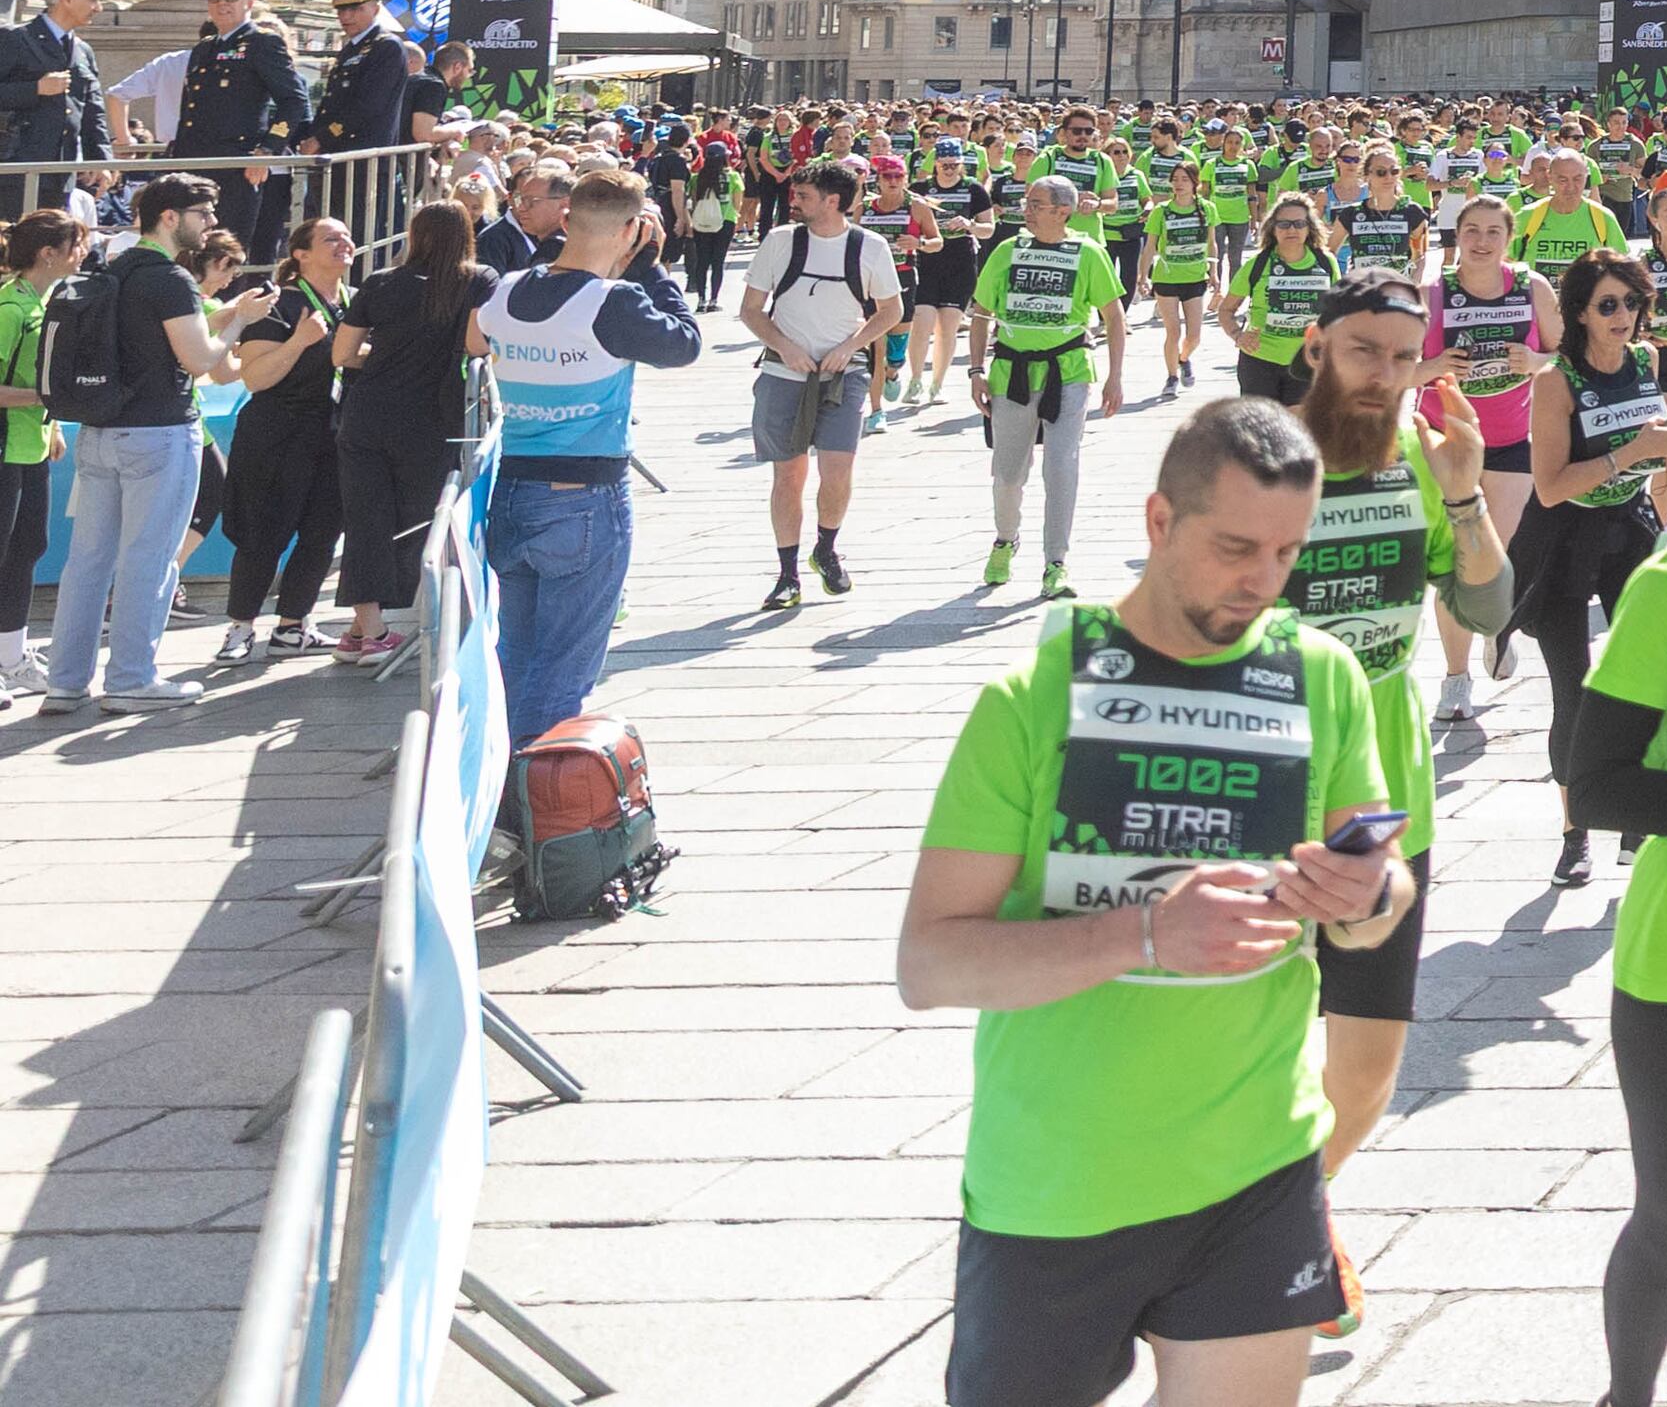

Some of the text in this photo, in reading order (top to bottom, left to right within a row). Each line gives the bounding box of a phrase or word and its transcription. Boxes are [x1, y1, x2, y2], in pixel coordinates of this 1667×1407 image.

[1264, 43, 1282, 57] M
[1537, 240, 1588, 253] STRA
[1034, 254, 1074, 264] HYUNDAI
[1016, 268, 1063, 283] STRA
[1284, 302, 1310, 310] STRA
[1474, 310, 1525, 319] HYUNDAI
[506, 344, 588, 366] ENDU pix
[1614, 404, 1663, 421] HYUNDAI
[1373, 468, 1409, 483] HOKA
[1322, 504, 1411, 526] HYUNDAI
[1295, 540, 1400, 574] 46018
[1308, 575, 1377, 600] STRA
[1362, 623, 1401, 646] BPM
[1243, 665, 1296, 692] HOKA
[1160, 704, 1292, 736] HYUNDAI
[1117, 753, 1262, 799] 7002
[1122, 801, 1233, 835] STRA
